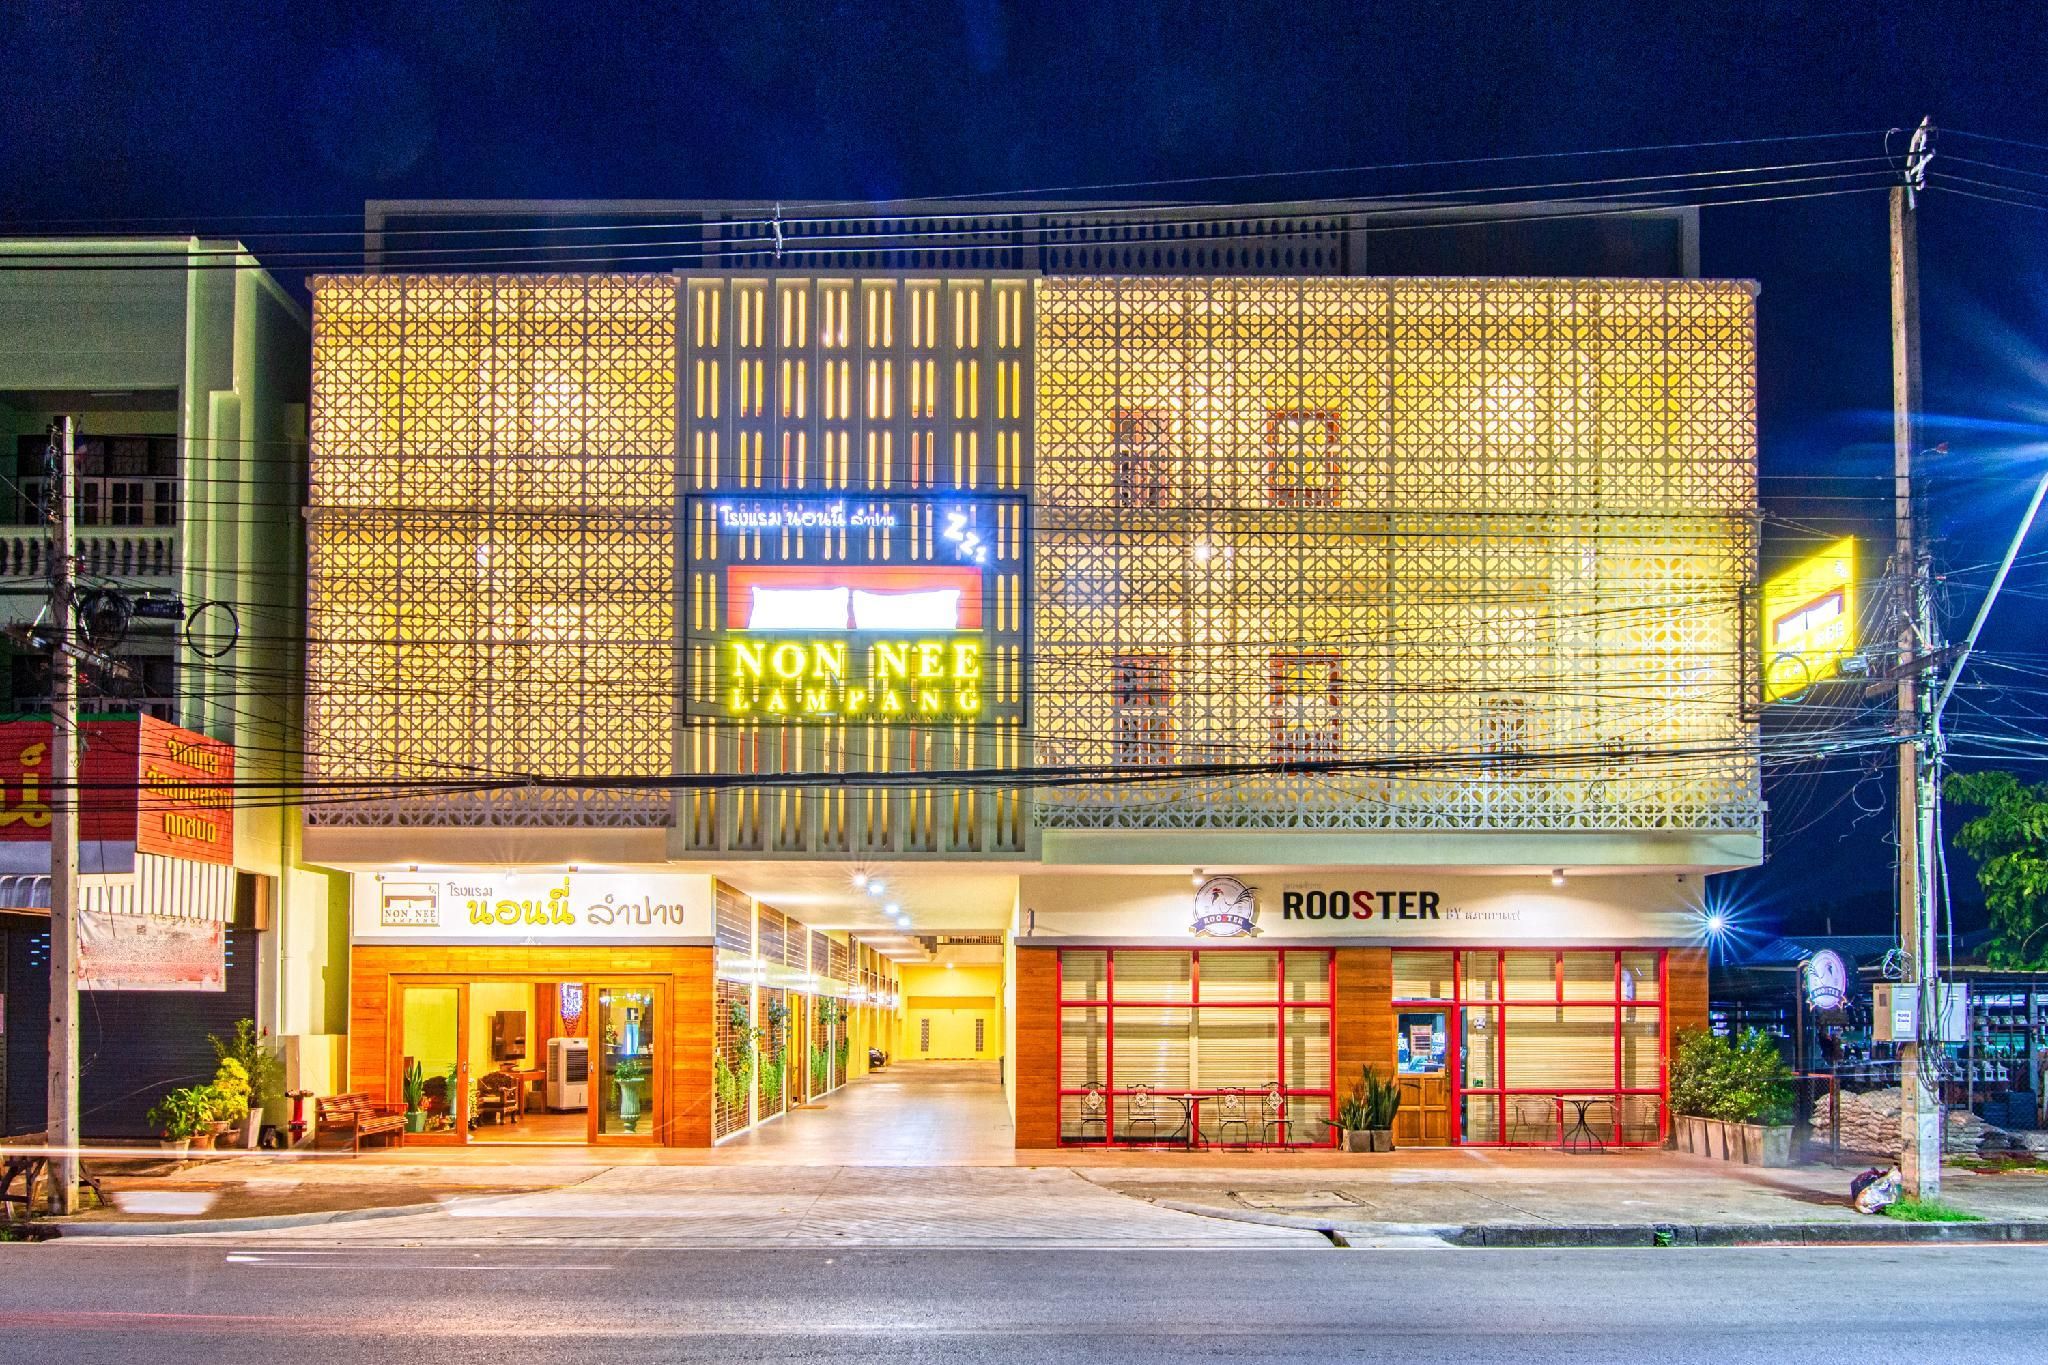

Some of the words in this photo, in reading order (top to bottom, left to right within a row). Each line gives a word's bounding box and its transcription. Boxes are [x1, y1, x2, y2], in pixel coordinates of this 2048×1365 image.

[718, 504, 781, 527] โรงแรม
[786, 500, 846, 527] นอนนี่
[850, 508, 895, 528] ลำปาง
[731, 643, 846, 679] NON
[876, 643, 981, 678] NEE
[731, 688, 981, 712] LAMPANG
[447, 882, 493, 897] โรงแรม
[467, 876, 576, 926] นอนนี่
[587, 894, 684, 925] ลำปาง
[385, 909, 409, 918] NON
[415, 909, 437, 918] NEE
[1284, 891, 1440, 919] ROOSTER
[1446, 906, 1462, 920] BY
[1203, 915, 1244, 926] ROOSTER
